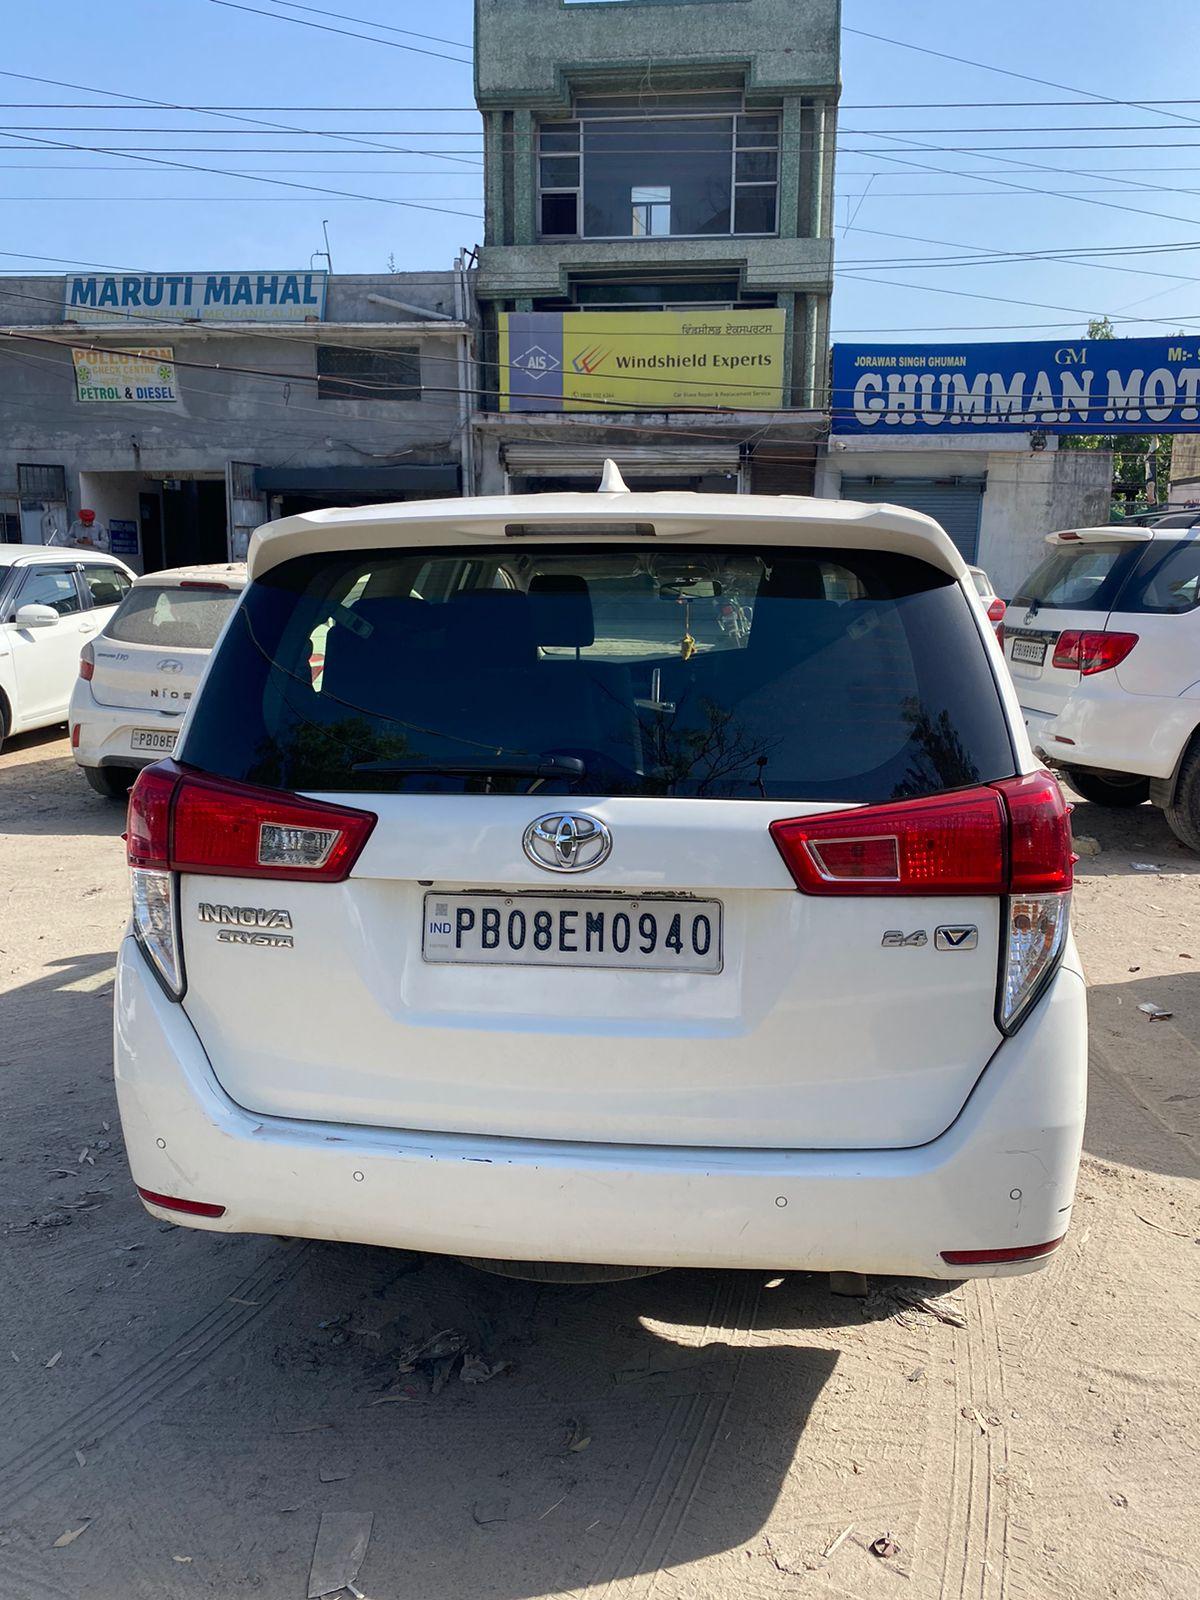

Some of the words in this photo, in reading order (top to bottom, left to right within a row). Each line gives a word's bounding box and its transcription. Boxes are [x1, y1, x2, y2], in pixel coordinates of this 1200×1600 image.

[71, 276, 193, 307] MARUTI
[203, 275, 319, 305] MAHAL
[528, 356, 547, 369] AIS
[616, 354, 707, 369] Windshield
[713, 353, 772, 369] Experts
[854, 356, 897, 367] JORAWAR
[898, 356, 926, 367] SINGH
[927, 356, 967, 367] GHUMAN
[1055, 347, 1088, 365] GM
[80, 387, 121, 400] PETROL
[125, 387, 133, 399] &
[136, 386, 175, 399] DIESEL
[853, 369, 1094, 426] GHUMMAN
[198, 902, 292, 929] INNOVA
[216, 929, 294, 947] CRYSTA
[429, 922, 452, 934] IND
[456, 907, 711, 956] PB08EM0940
